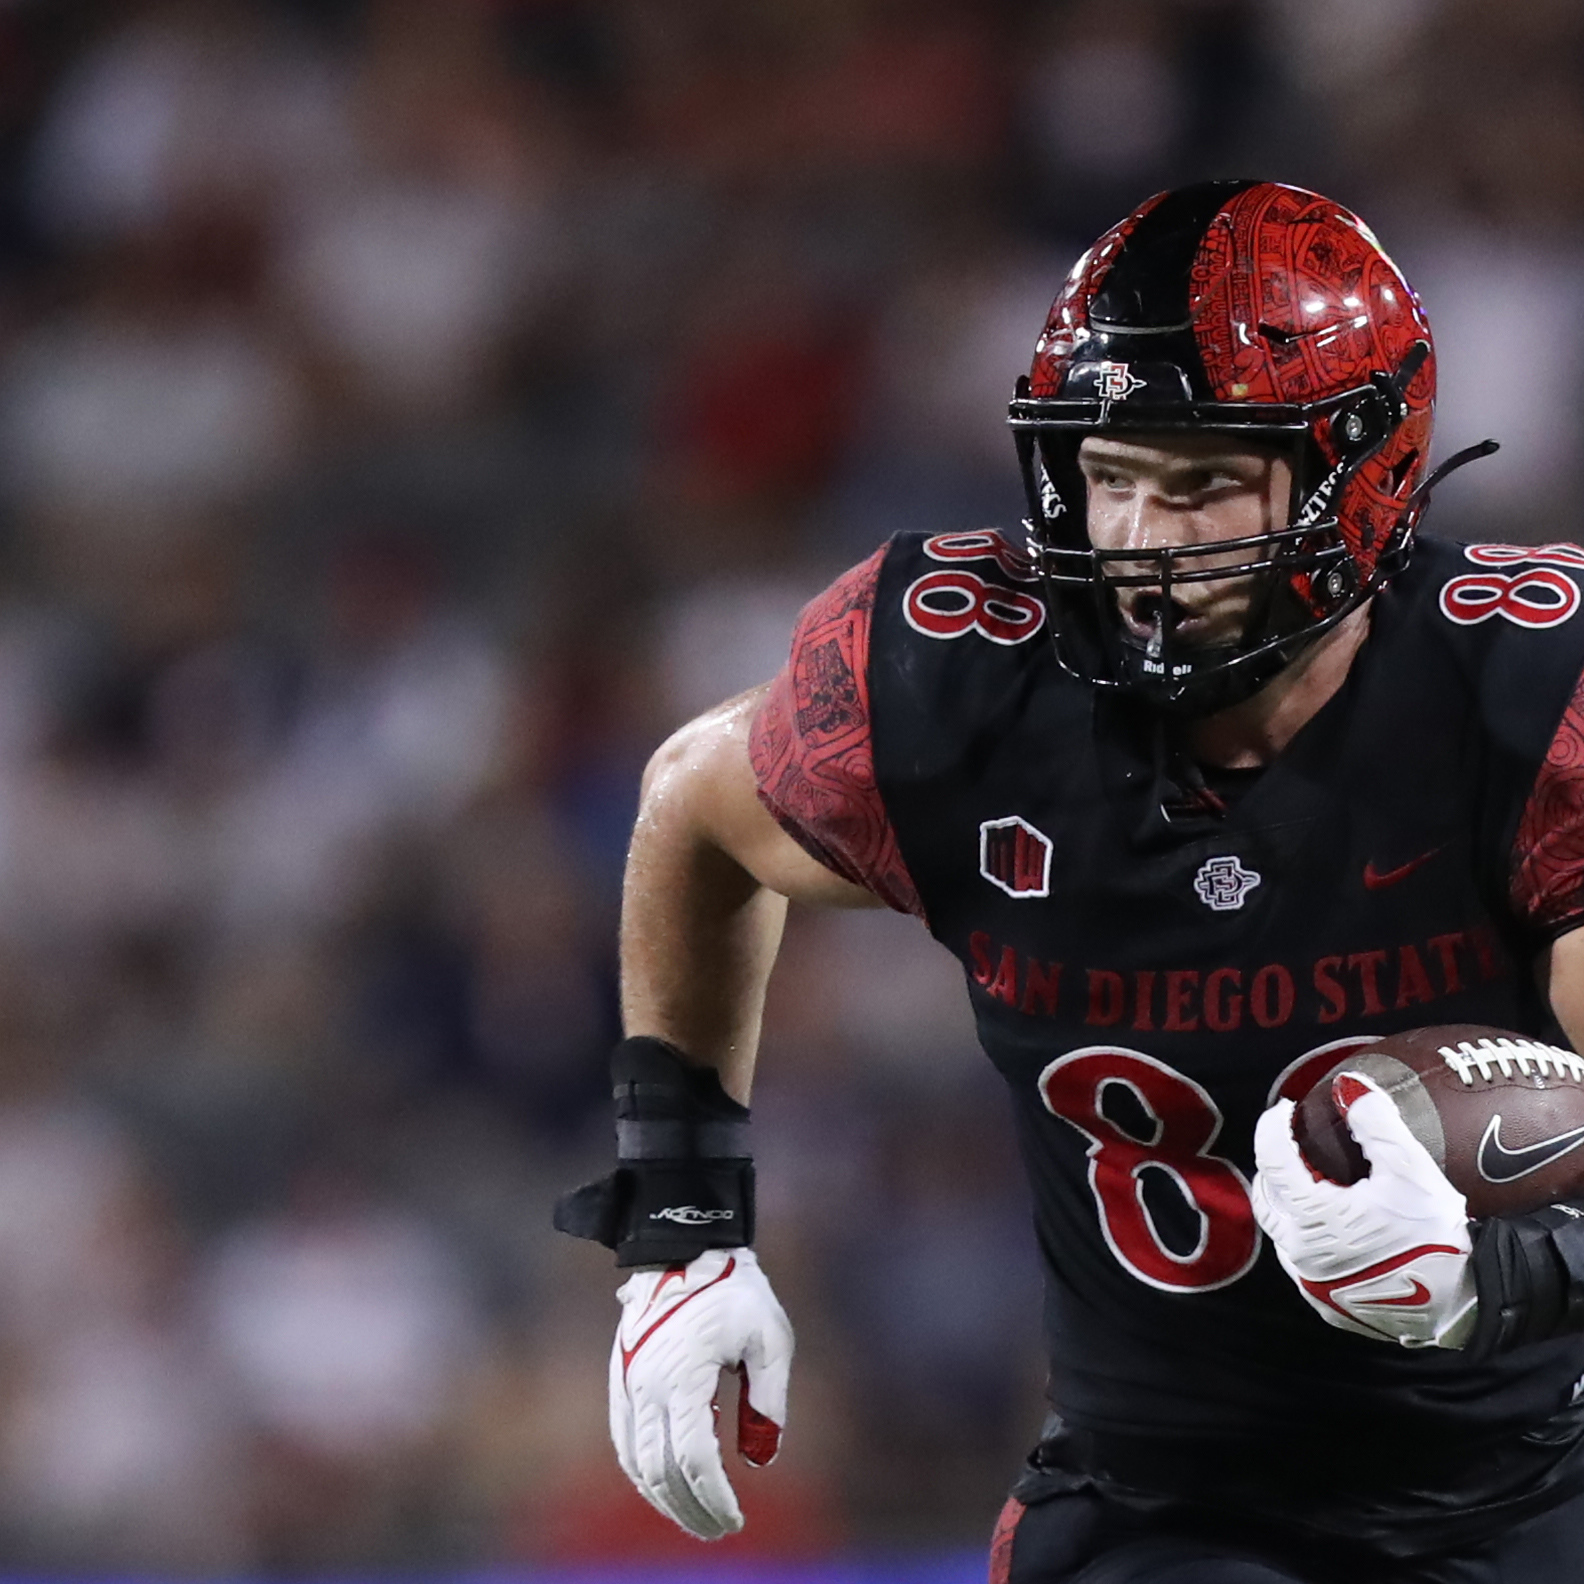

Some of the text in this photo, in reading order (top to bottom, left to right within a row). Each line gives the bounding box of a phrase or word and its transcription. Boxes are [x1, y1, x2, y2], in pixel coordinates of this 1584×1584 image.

[1040, 463, 1067, 518] TECS
[902, 529, 1046, 646] 88
[1143, 660, 1192, 677] Ridell
[969, 929, 1064, 1019] SAN
[1084, 963, 1297, 1032] DIEGO
[1037, 1035, 1386, 1294] 8
